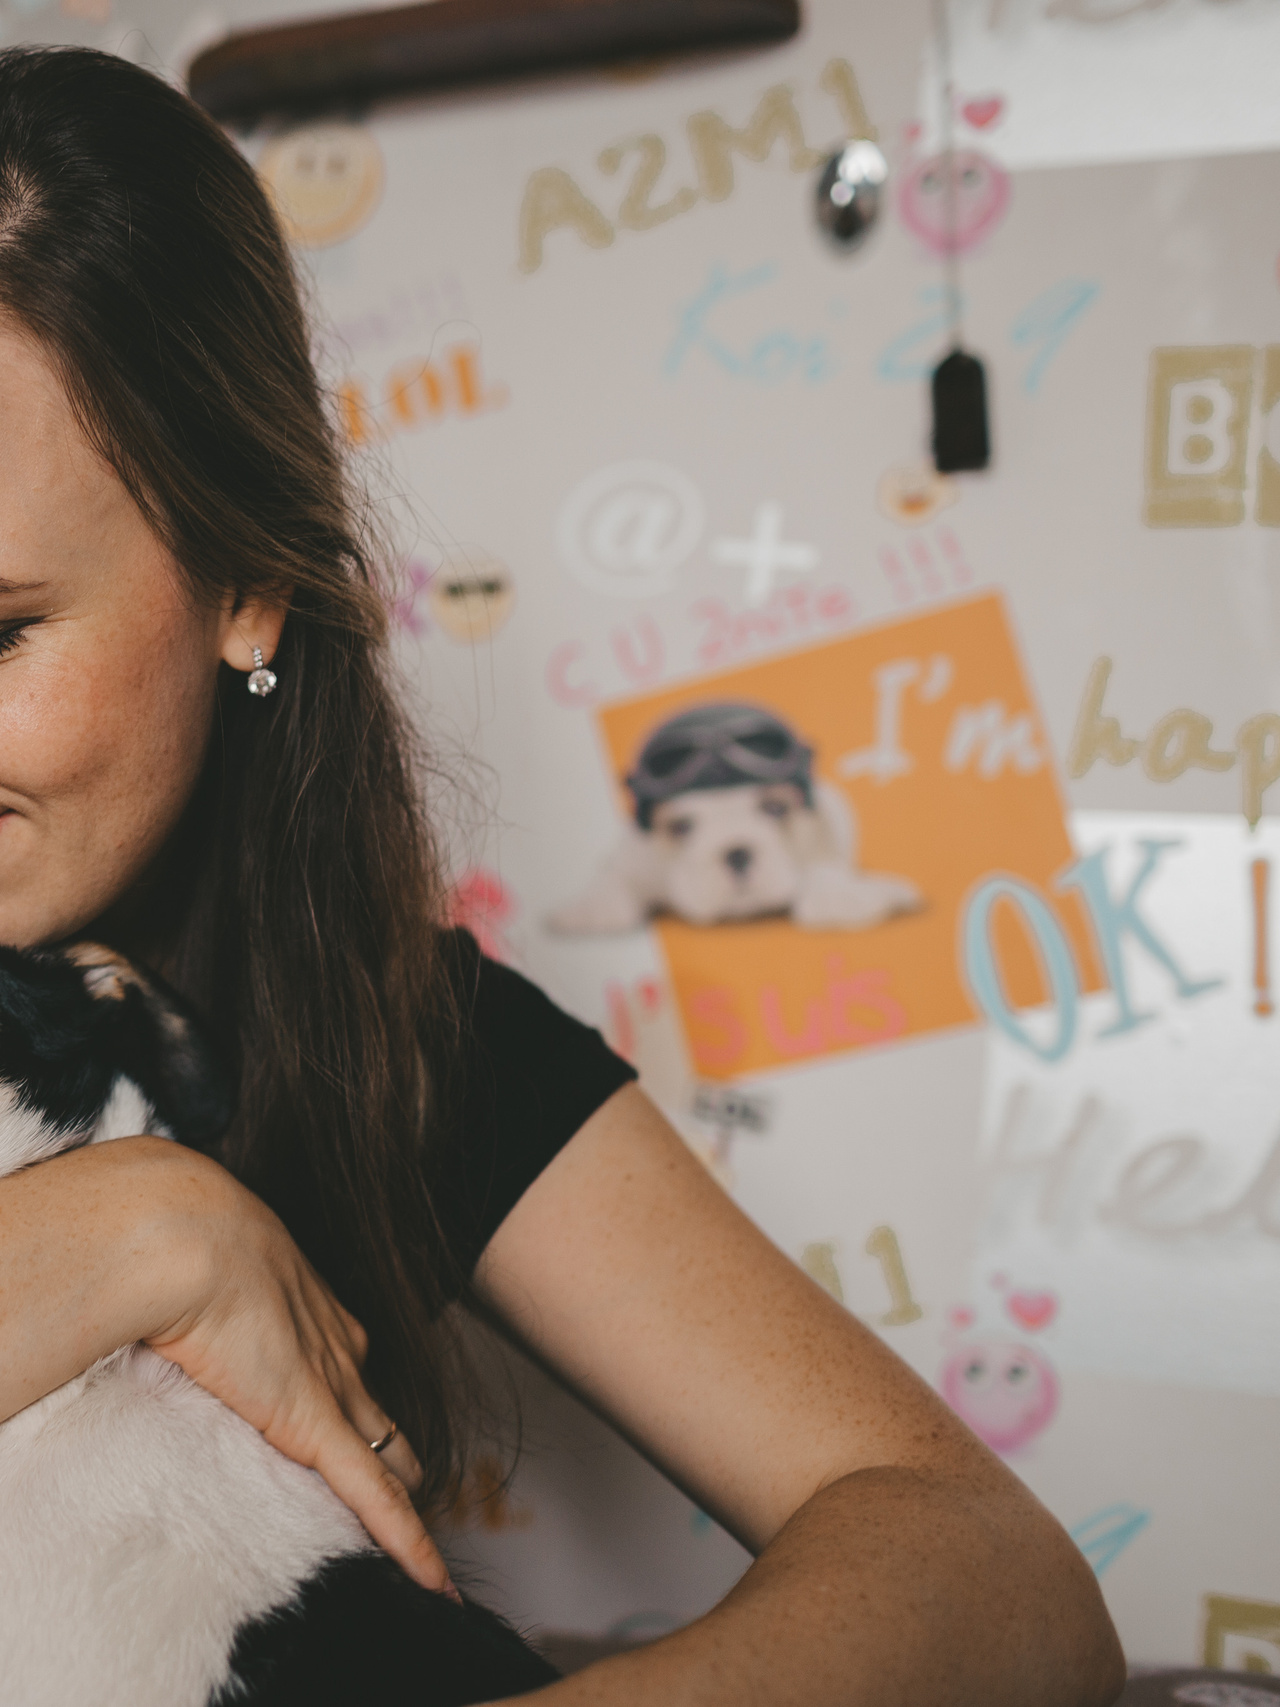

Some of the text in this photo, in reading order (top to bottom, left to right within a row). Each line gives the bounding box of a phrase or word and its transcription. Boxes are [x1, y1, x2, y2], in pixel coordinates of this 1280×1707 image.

[516, 58, 882, 276] A2M1
[834, 652, 1048, 785] I'm
[958, 832, 1228, 1064] OK
